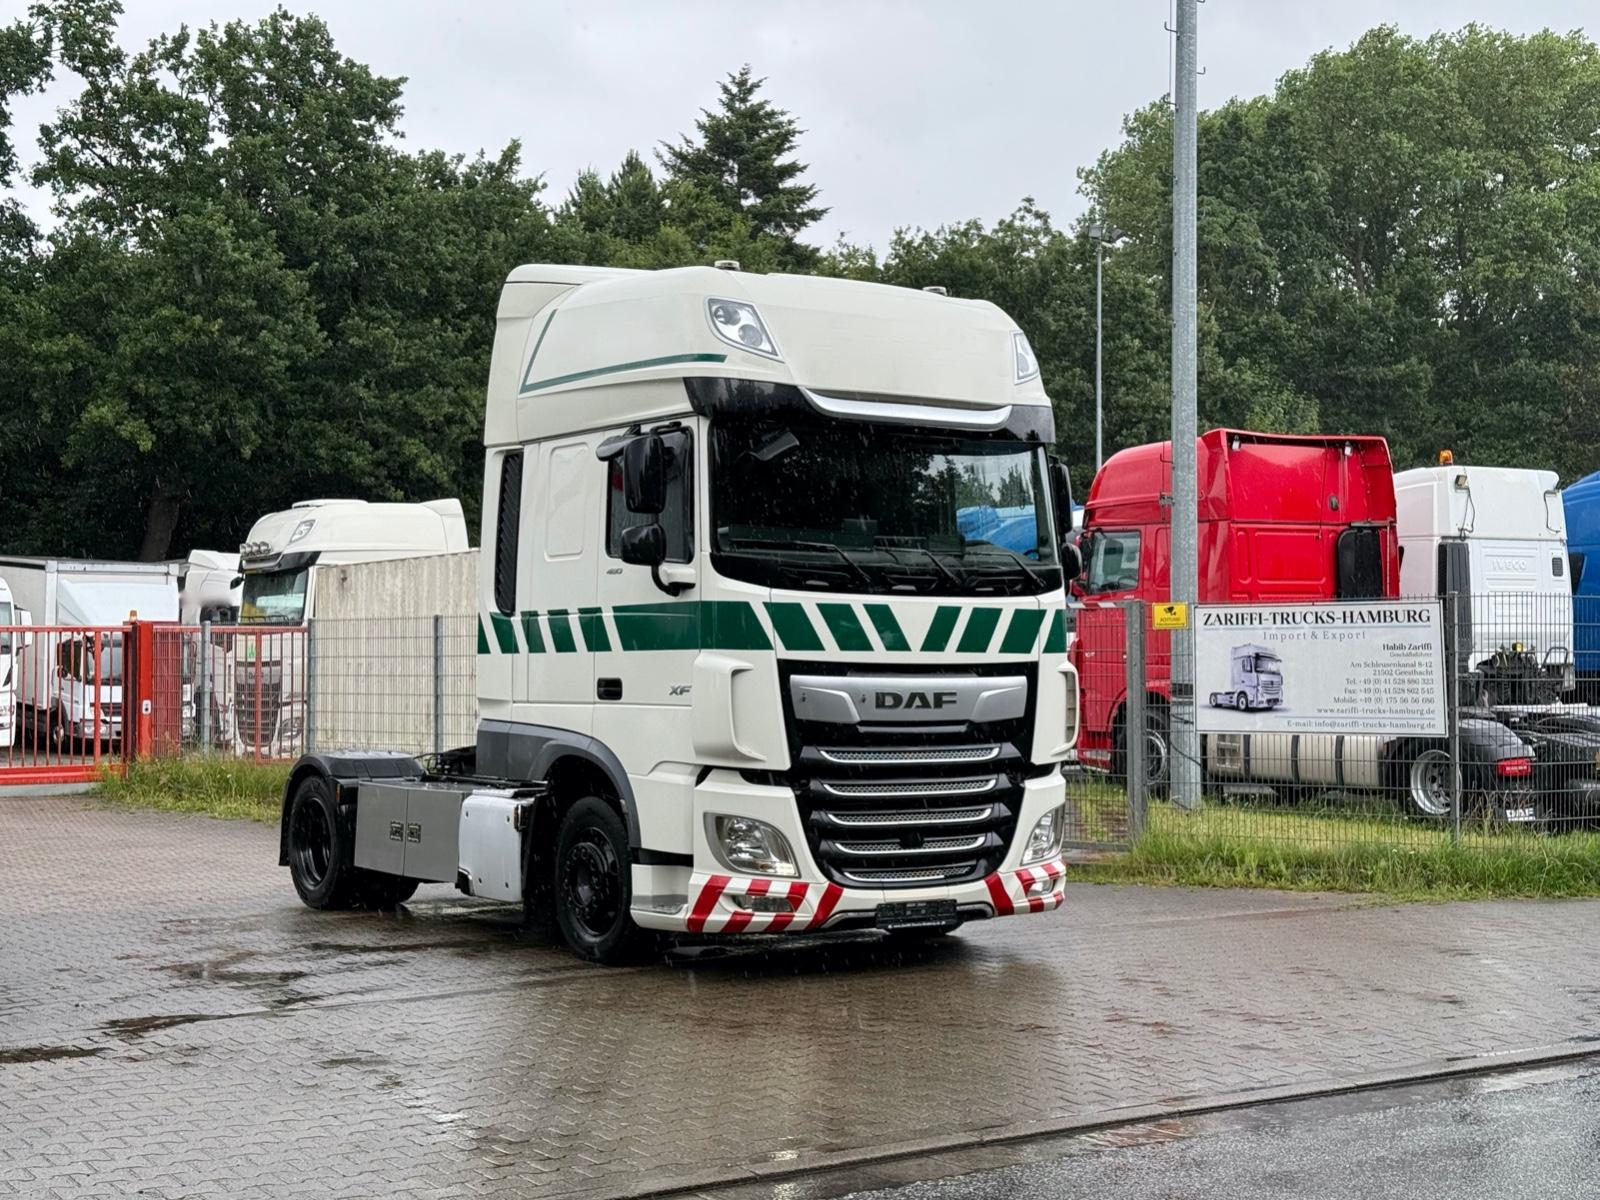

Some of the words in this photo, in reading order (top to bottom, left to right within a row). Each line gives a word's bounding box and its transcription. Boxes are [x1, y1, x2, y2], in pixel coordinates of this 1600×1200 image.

[1492, 558, 1527, 571] IVECO
[1203, 609, 1431, 626] ZARIFFI-TRUCKS-HAMBURG
[1263, 631, 1307, 641] Import
[1310, 631, 1318, 640] &
[1323, 630, 1366, 641] Export
[1383, 643, 1406, 651] Habib
[1408, 642, 1432, 651] Zariffi
[669, 685, 692, 696] XF
[874, 691, 958, 710] DAF
